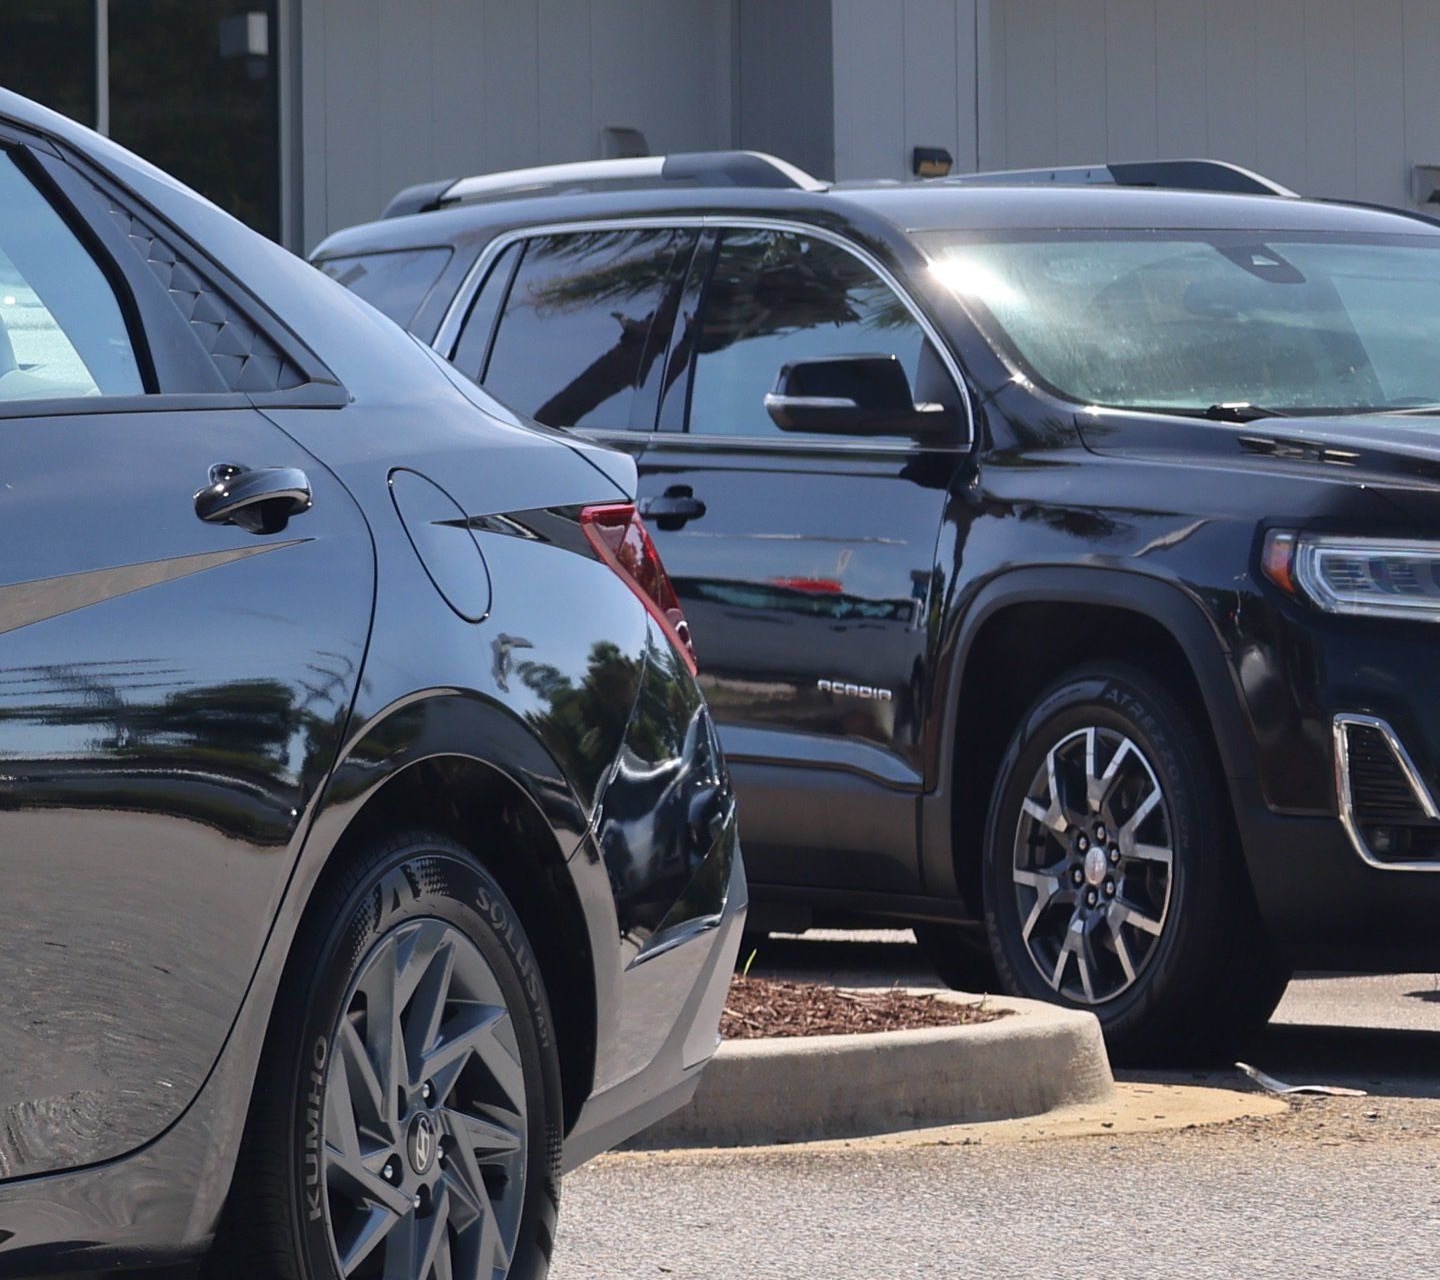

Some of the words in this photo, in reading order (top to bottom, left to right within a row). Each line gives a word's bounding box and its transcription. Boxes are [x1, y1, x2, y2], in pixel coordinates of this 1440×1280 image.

[817, 679, 892, 702] ACADIA
[475, 886, 542, 1006] SOLUS
[305, 1034, 328, 1221] KUMHO
